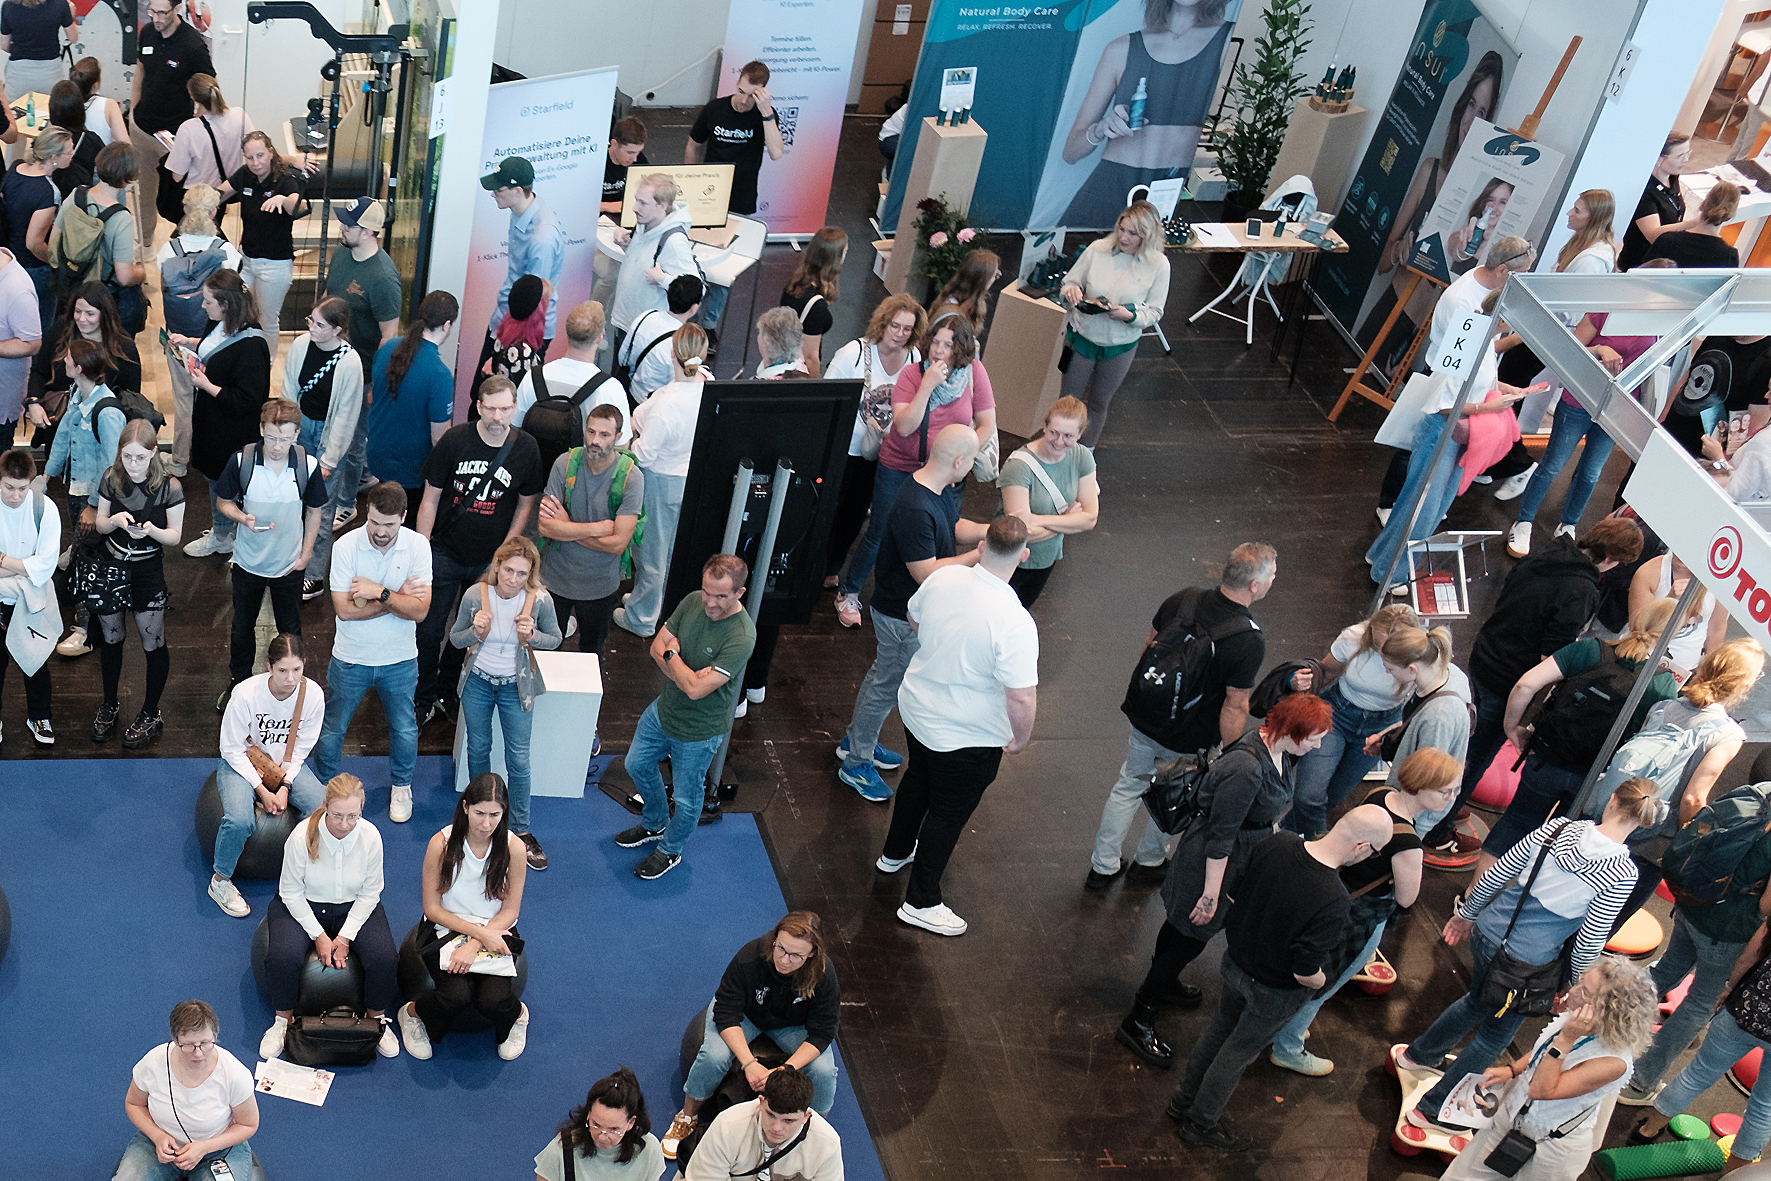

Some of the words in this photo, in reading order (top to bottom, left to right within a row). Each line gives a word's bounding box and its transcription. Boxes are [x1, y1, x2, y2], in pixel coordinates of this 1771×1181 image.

[959, 7, 1000, 16] Natural
[1003, 7, 1031, 17] Body
[1033, 7, 1059, 16] Care
[1625, 49, 1633, 61] 6
[1618, 66, 1626, 79] K
[439, 84, 446, 96] 6
[1610, 82, 1621, 97] 12
[531, 100, 574, 116] Starfield
[435, 118, 444, 131] 13
[713, 125, 754, 139] Starfield
[494, 140, 562, 158] Automatisiere
[564, 134, 592, 147] Deine
[571, 145, 587, 156] mit
[589, 143, 598, 153] KI
[1462, 318, 1473, 332] 6
[1453, 337, 1466, 351] K
[1442, 355, 1462, 371] 04
[473, 500, 496, 511] GOODS
[1732, 567, 1771, 637] TO
